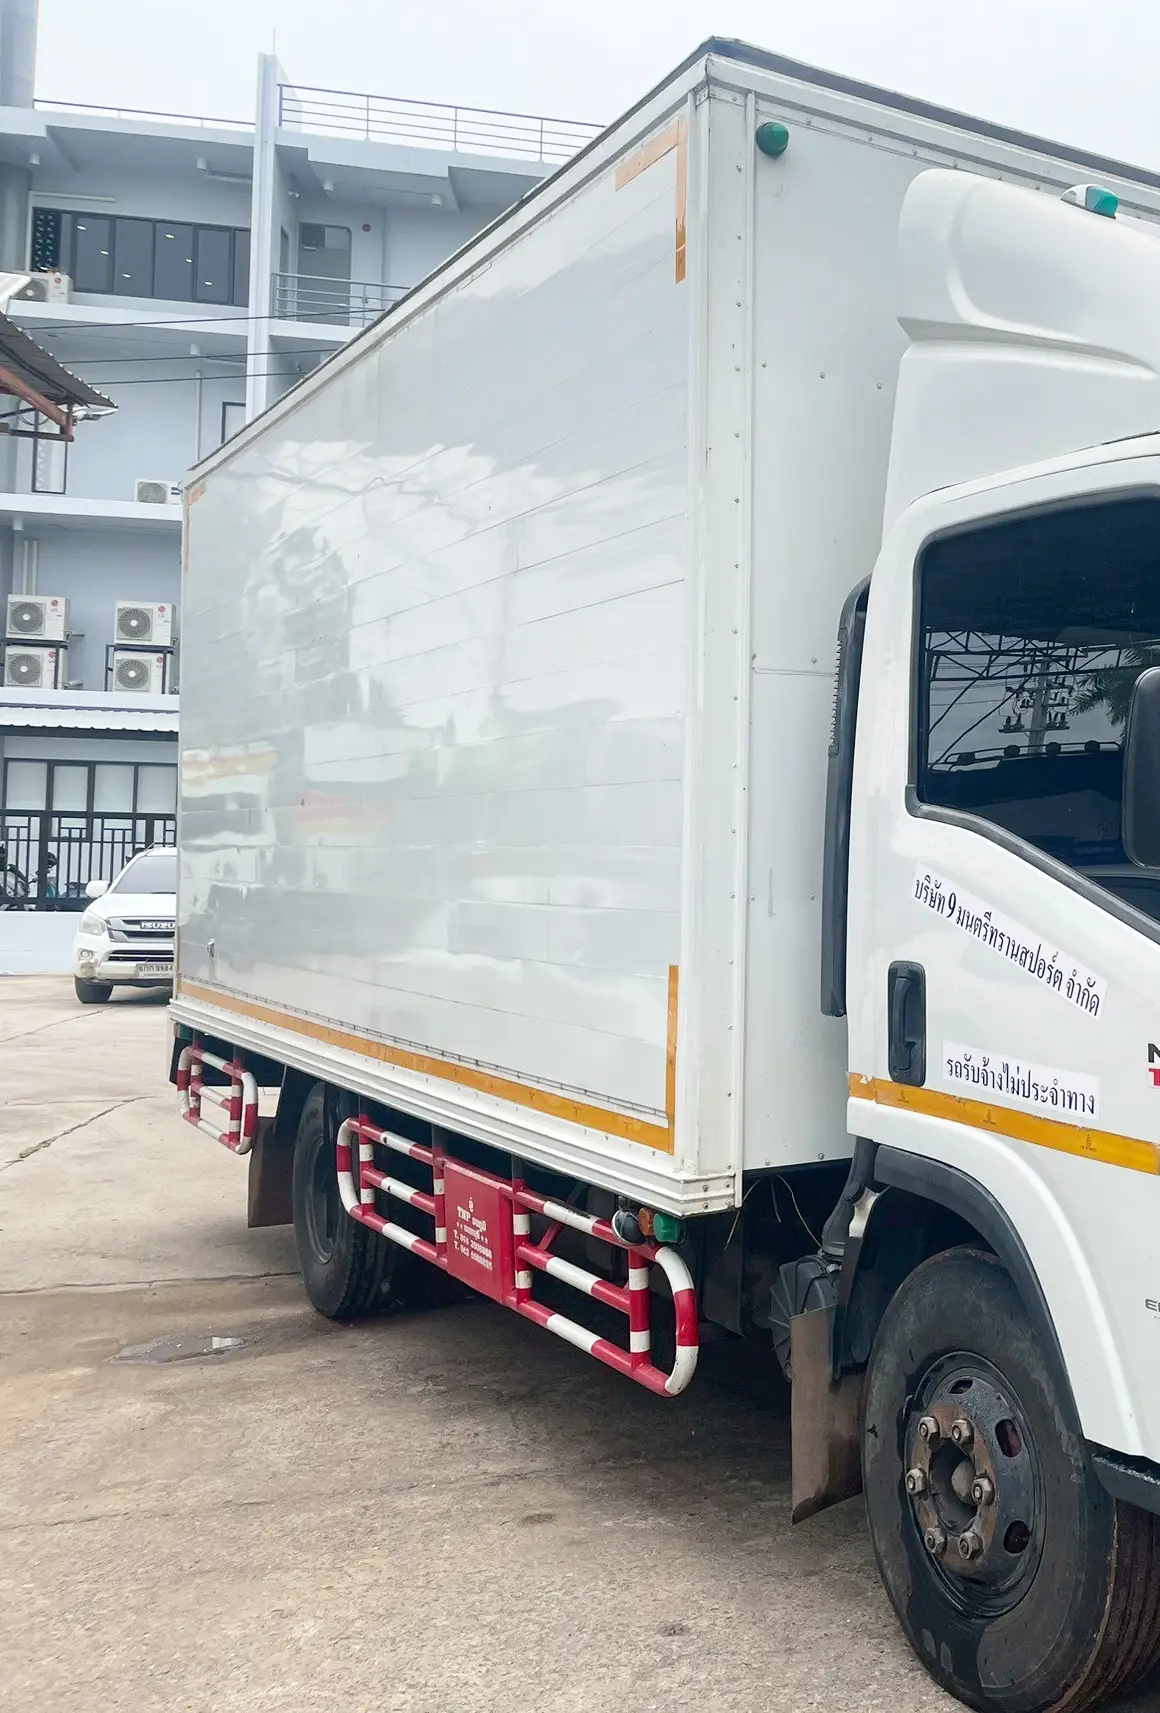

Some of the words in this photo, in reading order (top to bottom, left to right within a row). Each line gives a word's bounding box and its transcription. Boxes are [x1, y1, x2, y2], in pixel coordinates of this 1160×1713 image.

[1066, 969, 1100, 1017] จำกัด
[946, 1053, 1095, 1115] รถรับจ้างไม่ประจำทาง
